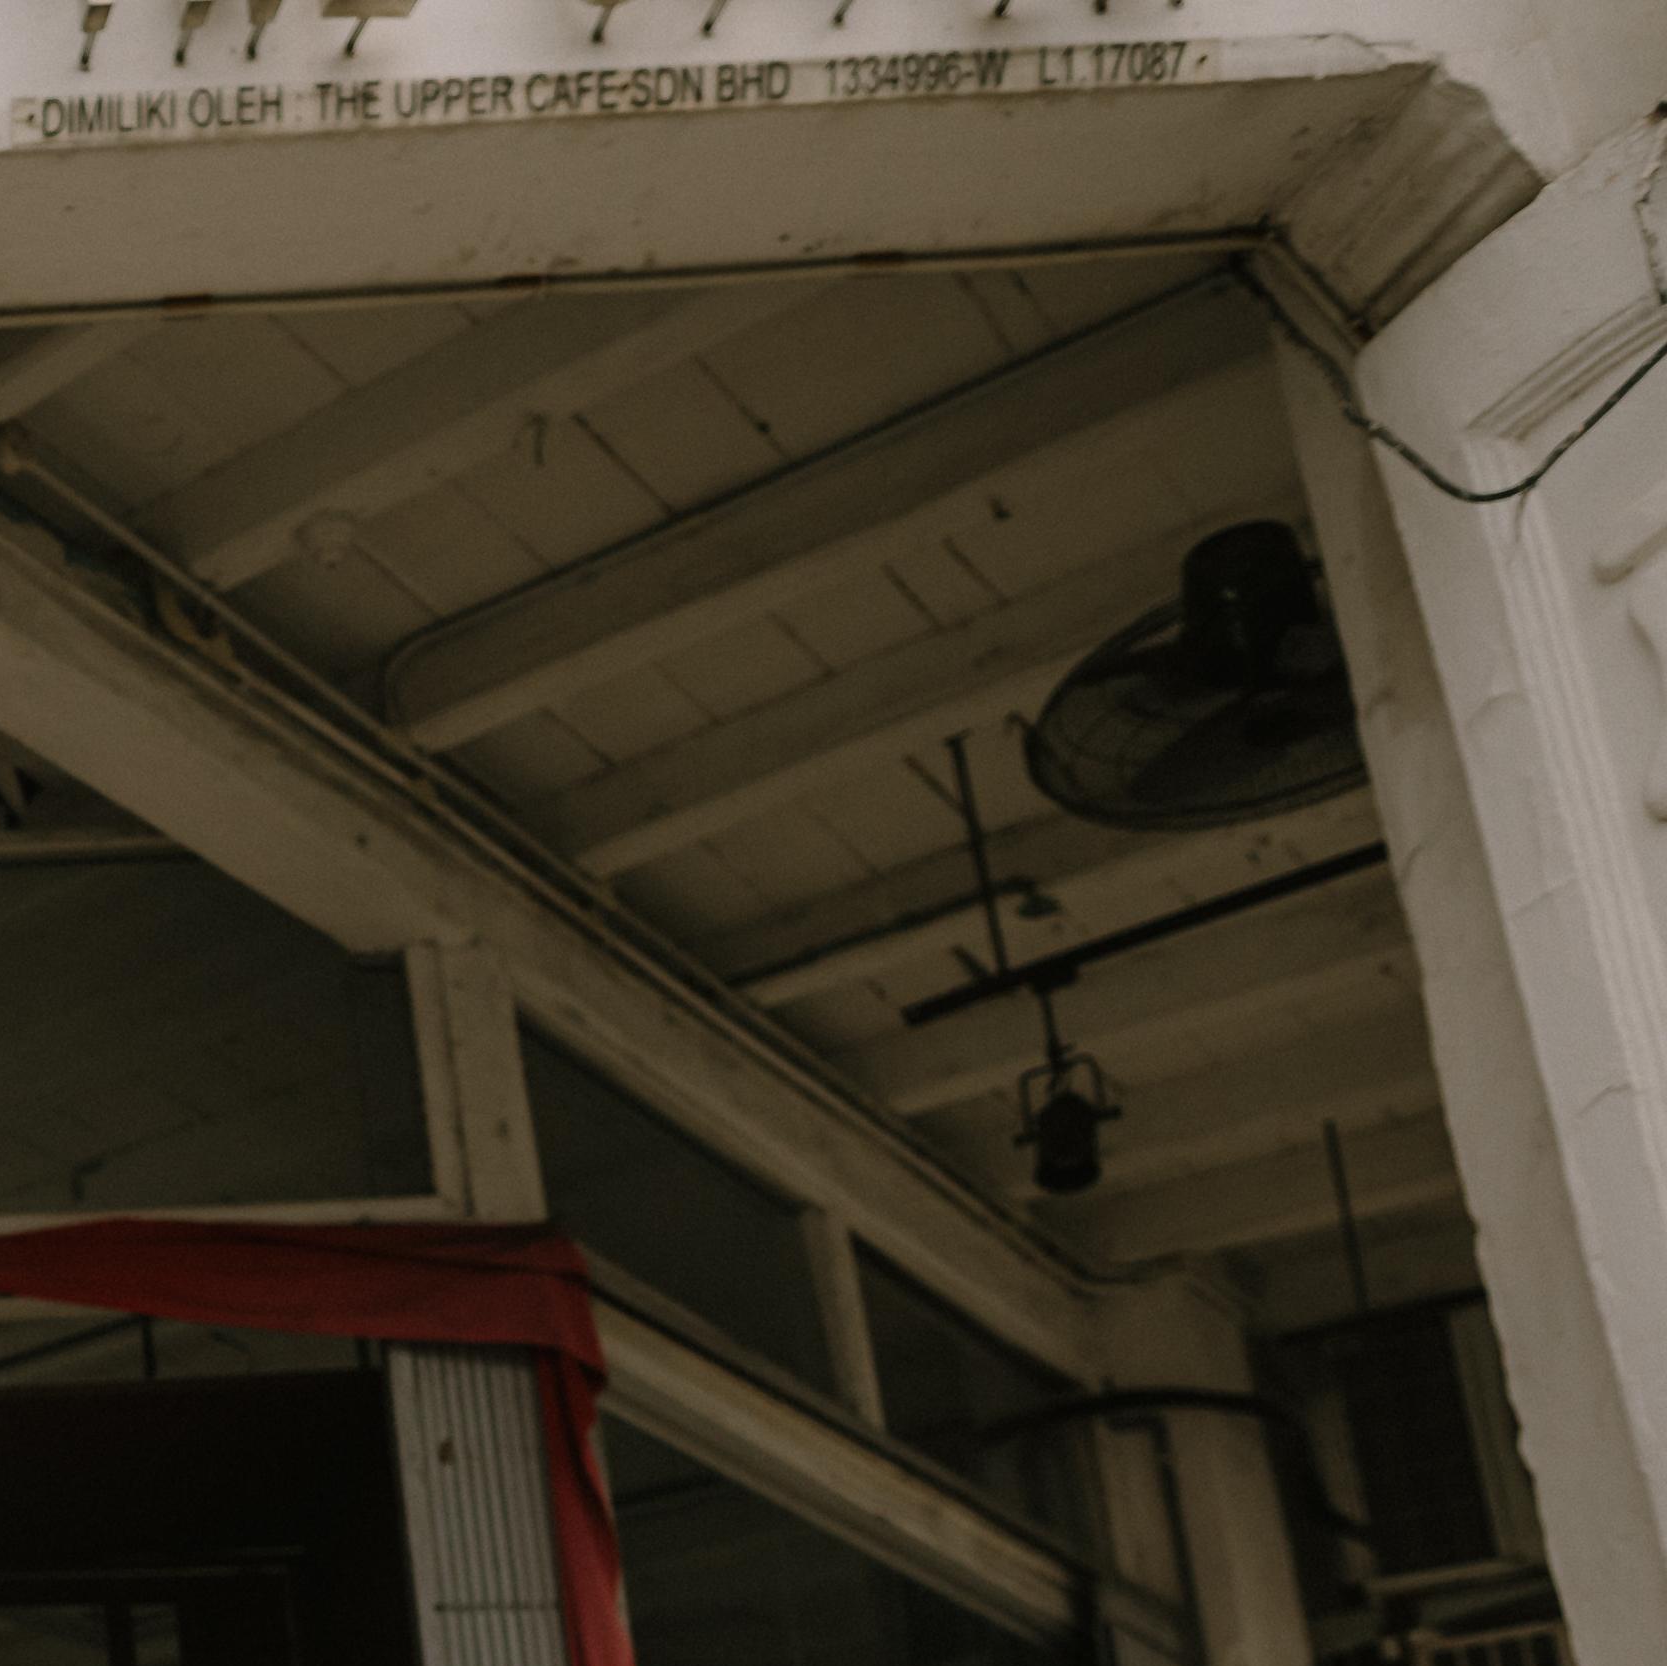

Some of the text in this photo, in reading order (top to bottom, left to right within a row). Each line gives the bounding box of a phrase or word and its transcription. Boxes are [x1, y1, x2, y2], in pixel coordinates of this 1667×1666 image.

[41, 88, 175, 138] DIMILIKI
[188, 85, 283, 130] OLEH
[316, 79, 381, 123] THE
[394, 74, 514, 119] UPPER
[525, 69, 620, 113] CAFE
[630, 65, 705, 107] SDN
[716, 61, 792, 102] BHD
